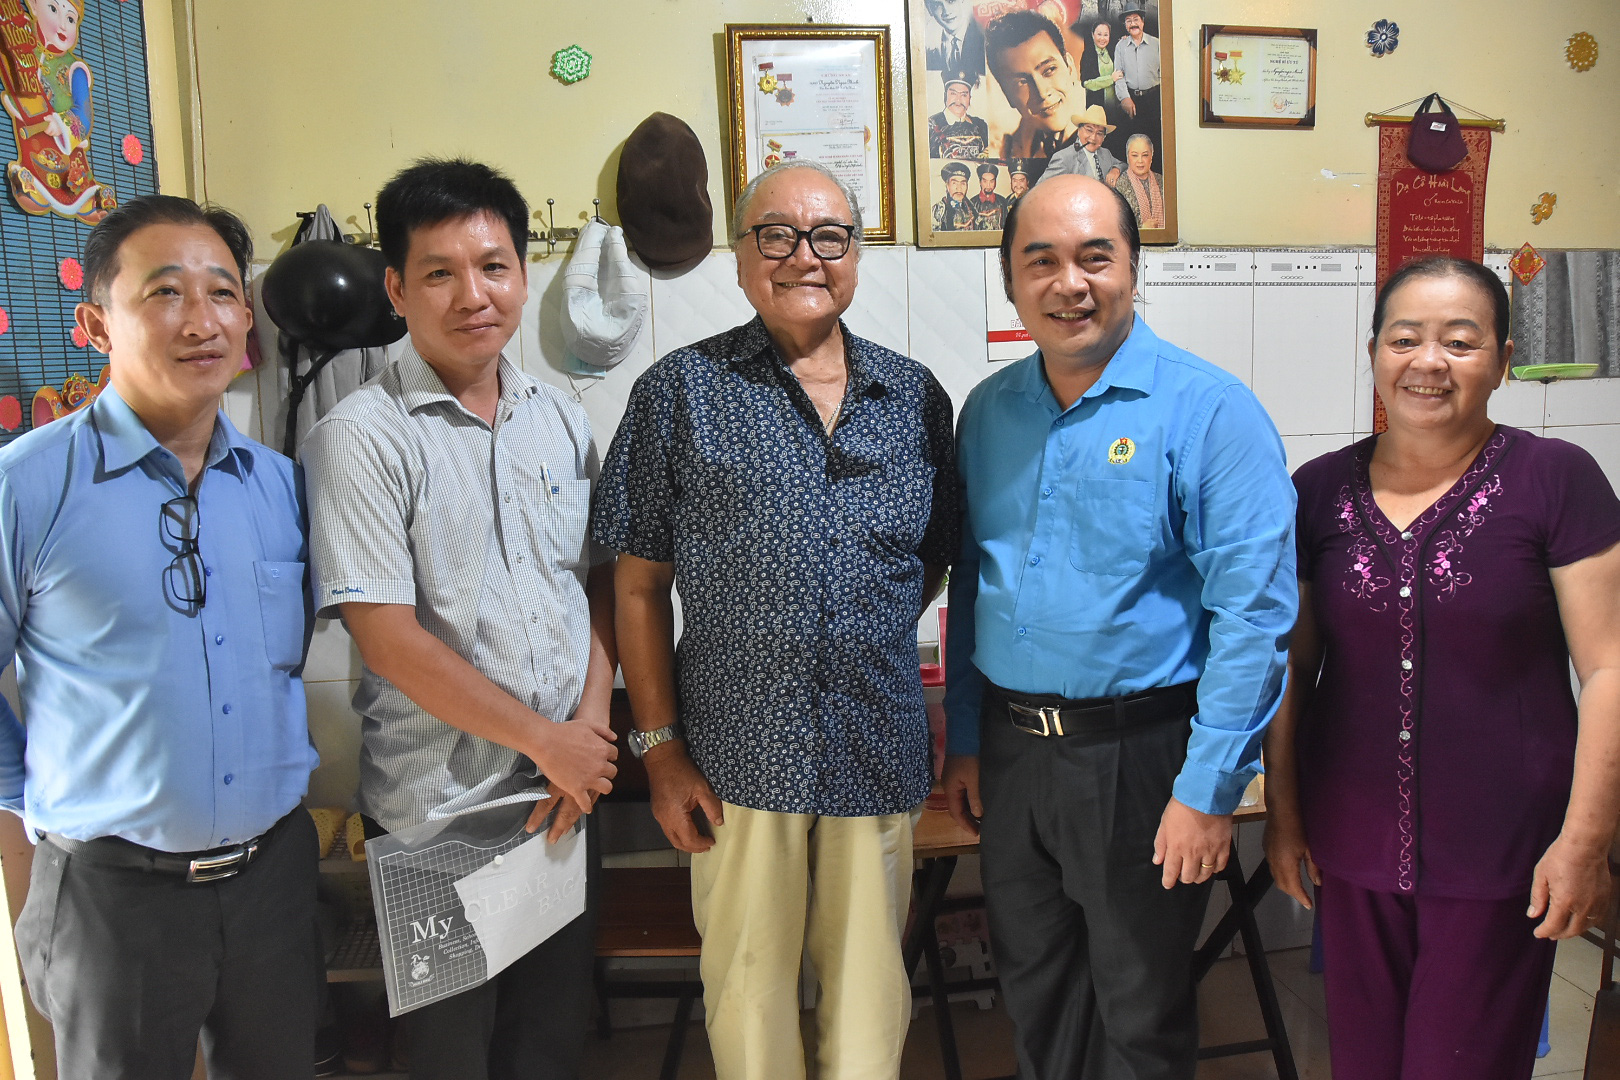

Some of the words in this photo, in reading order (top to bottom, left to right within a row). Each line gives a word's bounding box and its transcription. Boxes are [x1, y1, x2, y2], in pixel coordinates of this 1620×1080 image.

[1, 21, 36, 48] Mừng
[19, 71, 41, 94] Mới
[410, 914, 454, 944] My
